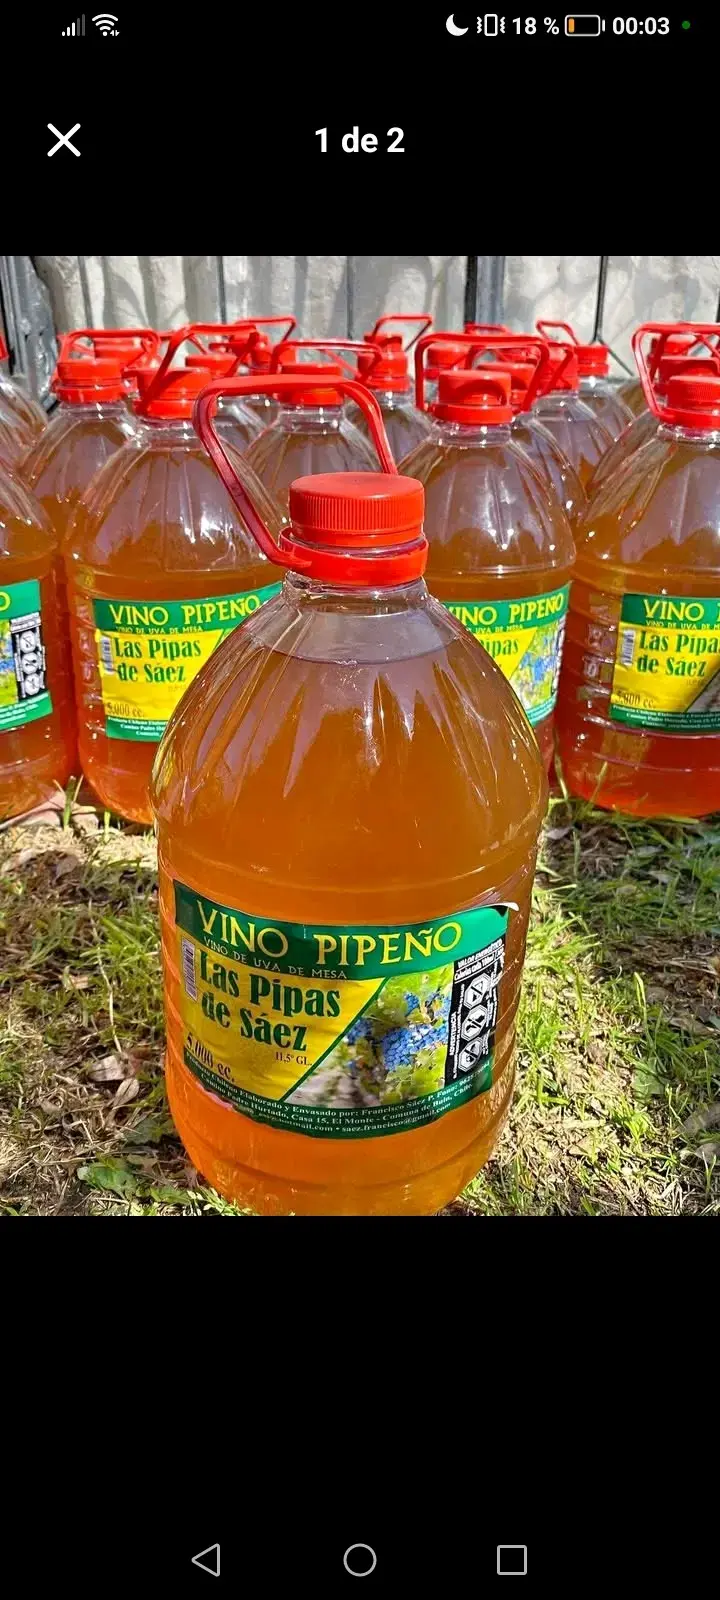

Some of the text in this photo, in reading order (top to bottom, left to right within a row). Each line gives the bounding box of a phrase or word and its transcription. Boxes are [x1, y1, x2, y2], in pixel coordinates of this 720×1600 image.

[109, 595, 260, 626] VINO PIPEÑO
[509, 594, 564, 624] PIPEÑO
[643, 599, 705, 622] VINO
[114, 637, 201, 661] Las Pipas
[639, 630, 720, 656] Las Pipa
[117, 662, 138, 682] de
[636, 654, 659, 673] de
[196, 900, 462, 967] VINO PIPEÑO
[204, 935, 348, 979] VINO DE UVA DE MESA
[199, 949, 341, 1019] Las Pipas
[201, 990, 308, 1052] de Sáez
[185, 1032, 235, 1083] 5.000 cc.
[227, 1091, 250, 1106] Padre
[251, 1102, 289, 1119] Hurtado,
[291, 1114, 313, 1123] Casa
[383, 1108, 419, 1121] Comuna
[421, 1103, 432, 1112] de
[239, 1090, 283, 1110] Elaborado
[292, 1106, 337, 1118] Envasado
[361, 1105, 403, 1117] Francisco
